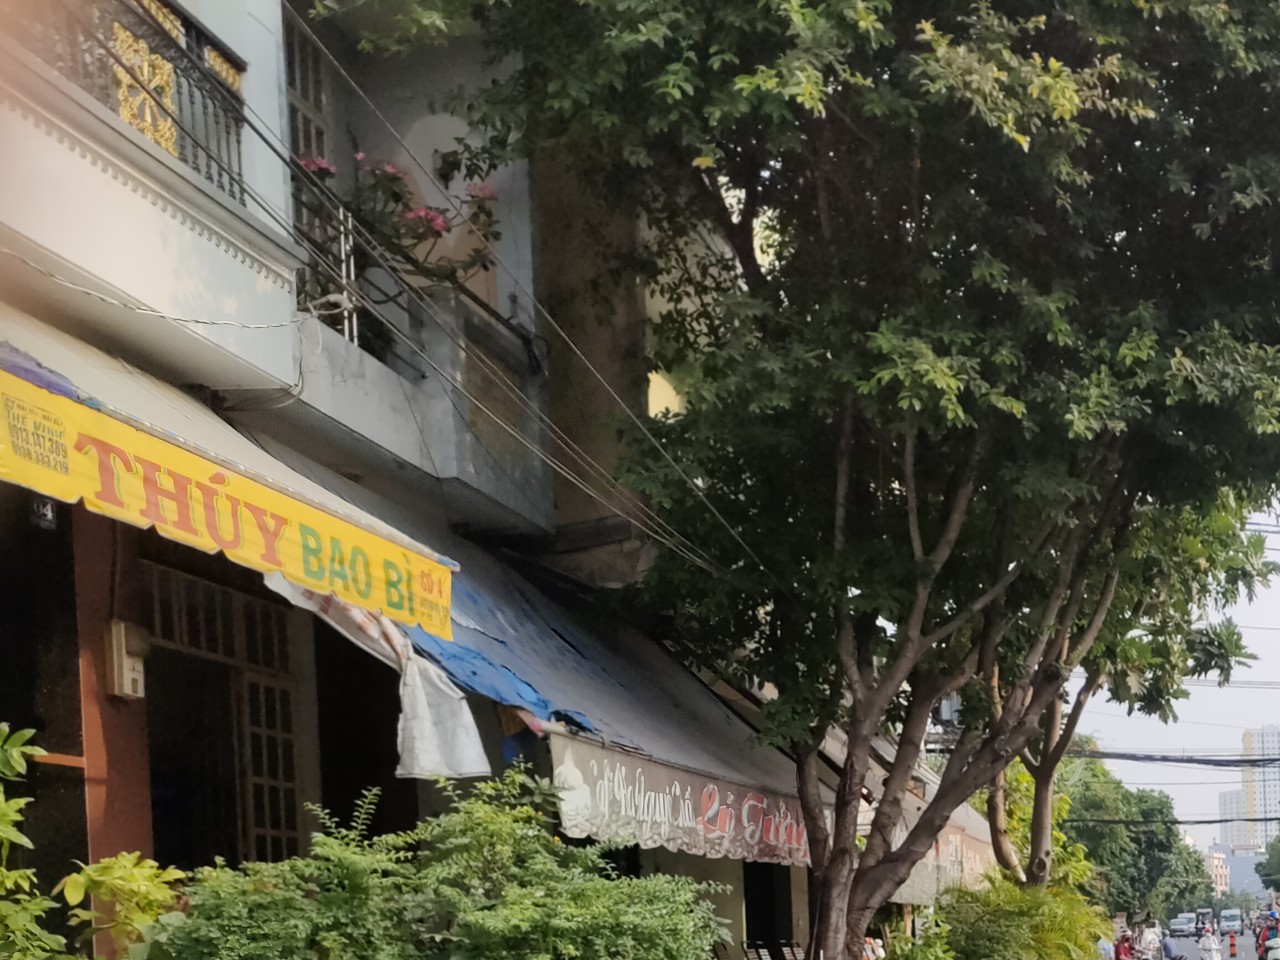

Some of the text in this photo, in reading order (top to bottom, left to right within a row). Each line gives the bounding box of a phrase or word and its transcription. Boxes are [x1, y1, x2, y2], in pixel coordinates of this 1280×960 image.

[74, 431, 290, 568] THÚY
[299, 521, 372, 600] BAO
[383, 551, 416, 617] BÌ
